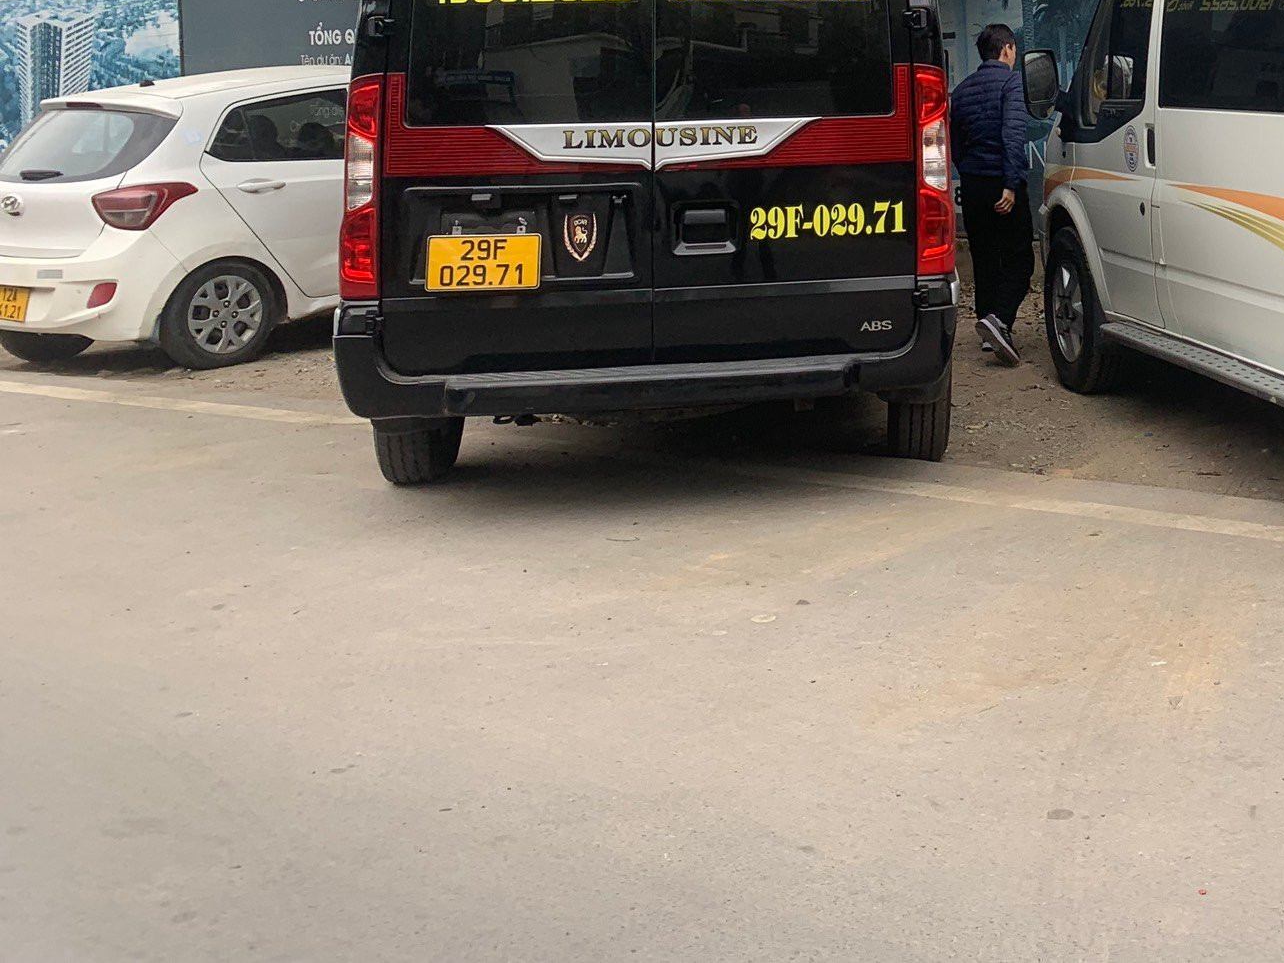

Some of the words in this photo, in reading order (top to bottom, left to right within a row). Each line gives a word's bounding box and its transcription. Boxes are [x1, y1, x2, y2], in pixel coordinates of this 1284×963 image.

[309, 22, 341, 45] TỔNG
[563, 125, 758, 150] LIMOUSINE
[750, 200, 906, 240] 29F-029.71
[460, 239, 508, 261] 29F
[440, 263, 523, 287] 029.71
[861, 320, 893, 332] ABS
